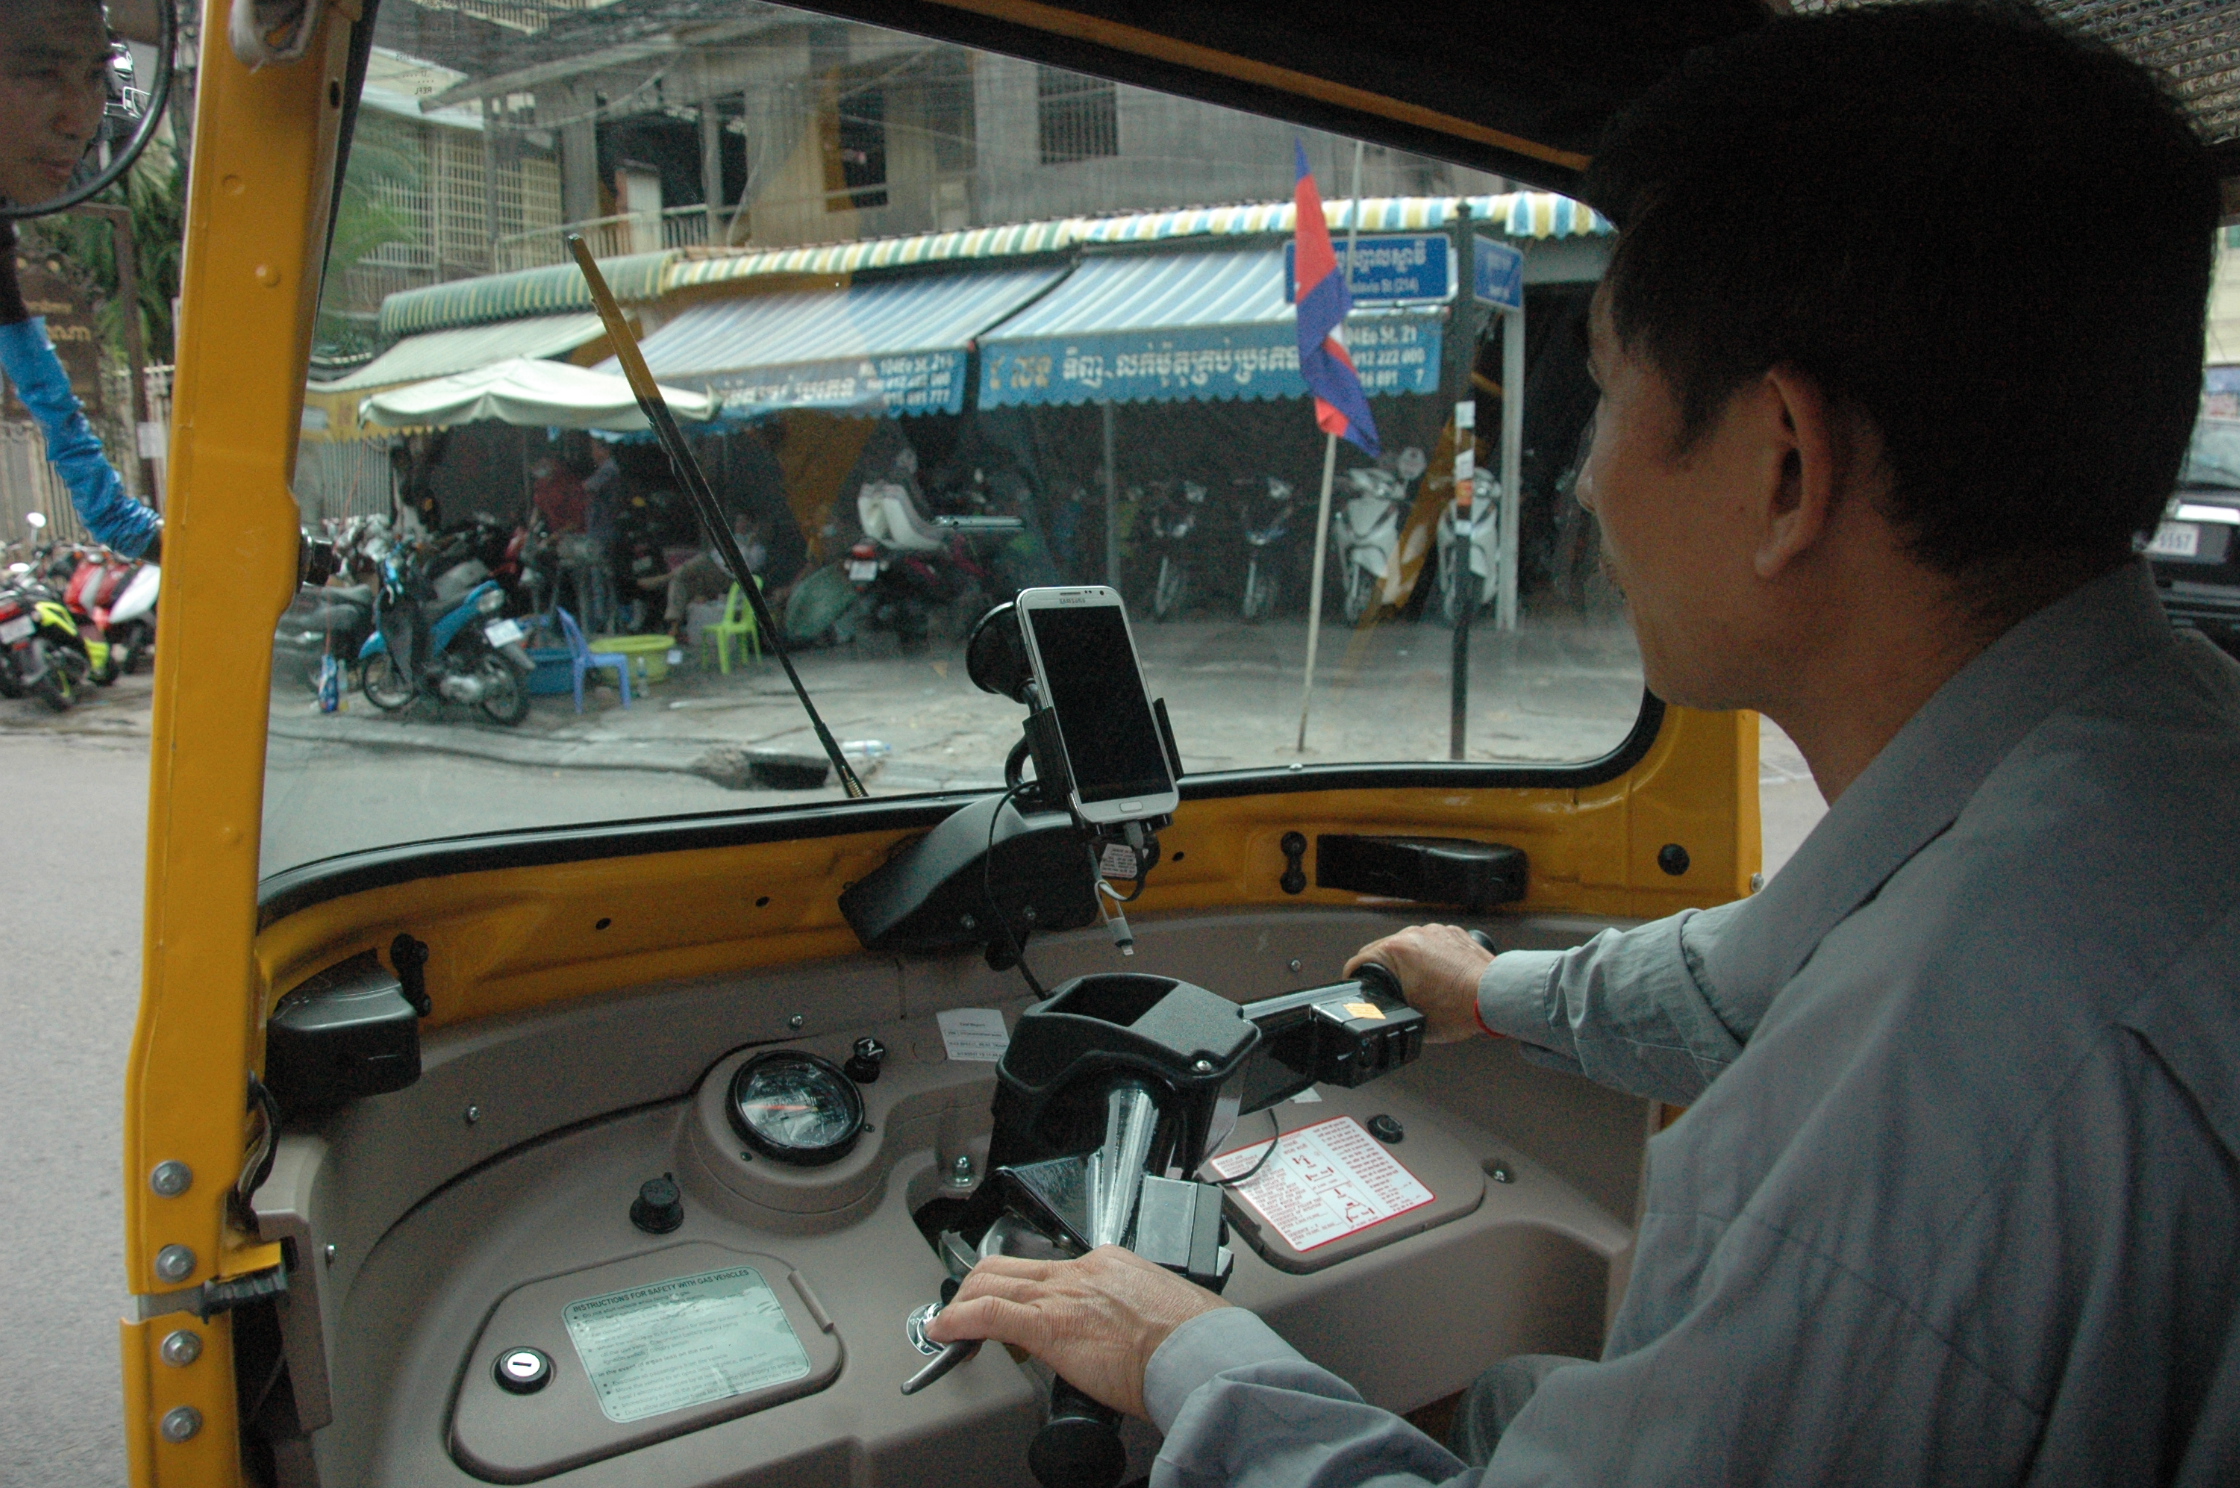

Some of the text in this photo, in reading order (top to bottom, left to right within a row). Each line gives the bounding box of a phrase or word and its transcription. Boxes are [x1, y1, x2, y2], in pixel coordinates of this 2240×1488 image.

[574, 1295, 629, 1312] INSTRUCTIONS
[631, 1291, 647, 1299] FOR
[648, 1284, 676, 1295] SAFETY
[714, 1270, 749, 1280] VEHICLES
